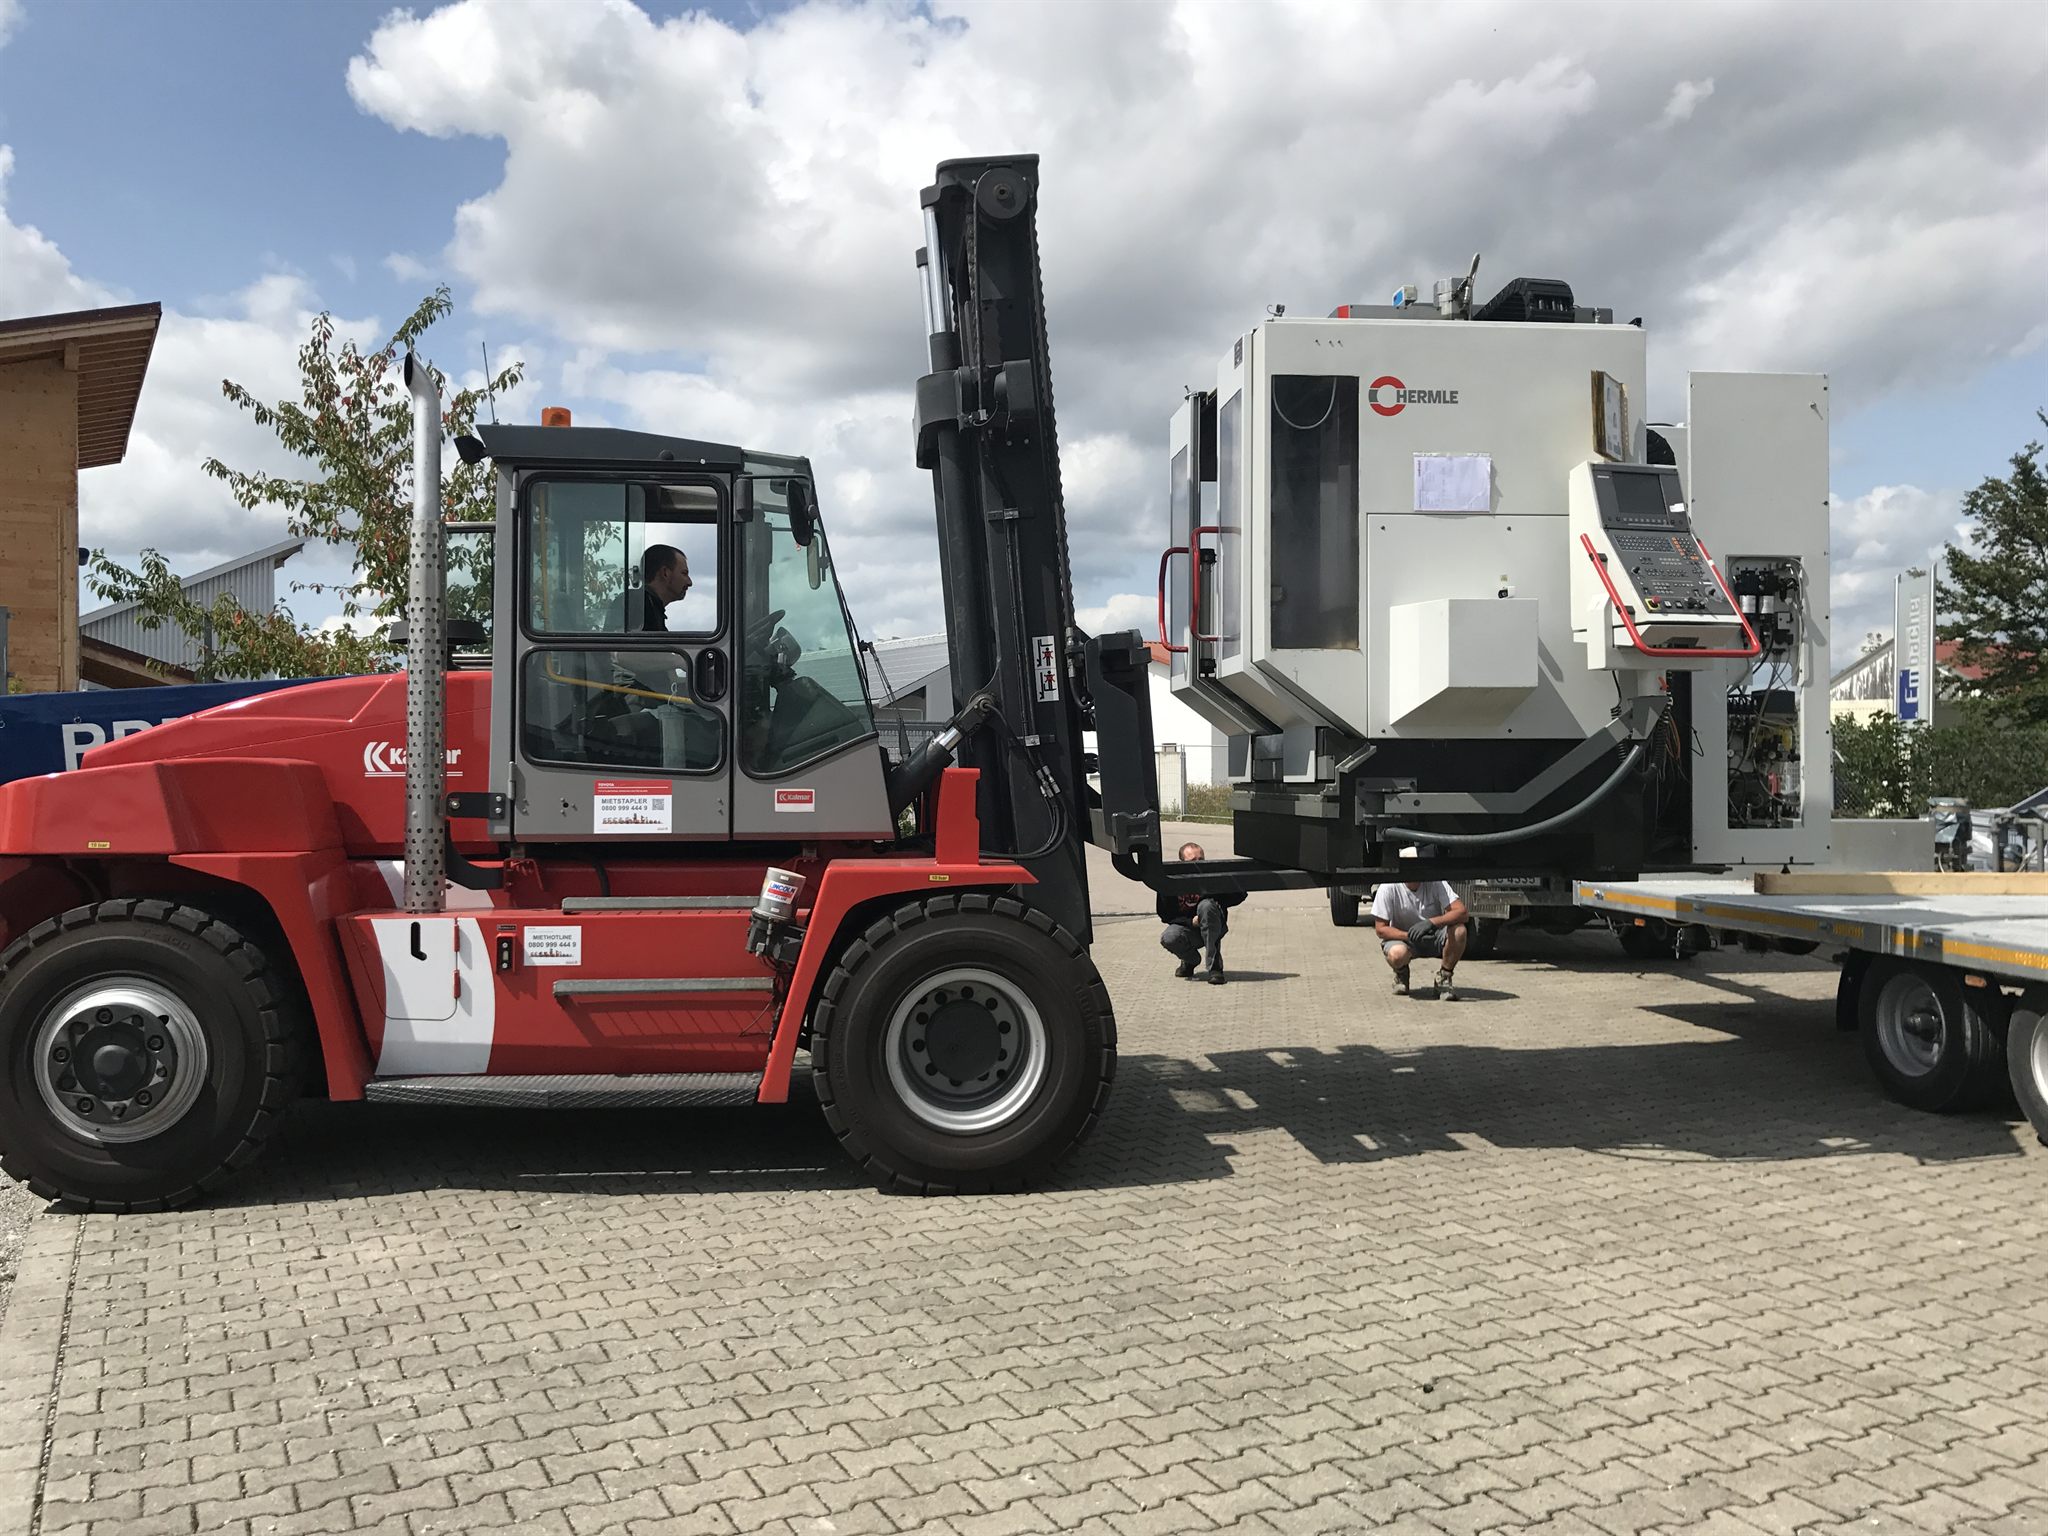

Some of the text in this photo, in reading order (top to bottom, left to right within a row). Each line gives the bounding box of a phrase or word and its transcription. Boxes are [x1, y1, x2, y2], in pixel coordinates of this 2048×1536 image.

[1396, 389, 1459, 404] HERMLE
[787, 793, 811, 801] Kalmar
[769, 882, 797, 894] LINCOLN
